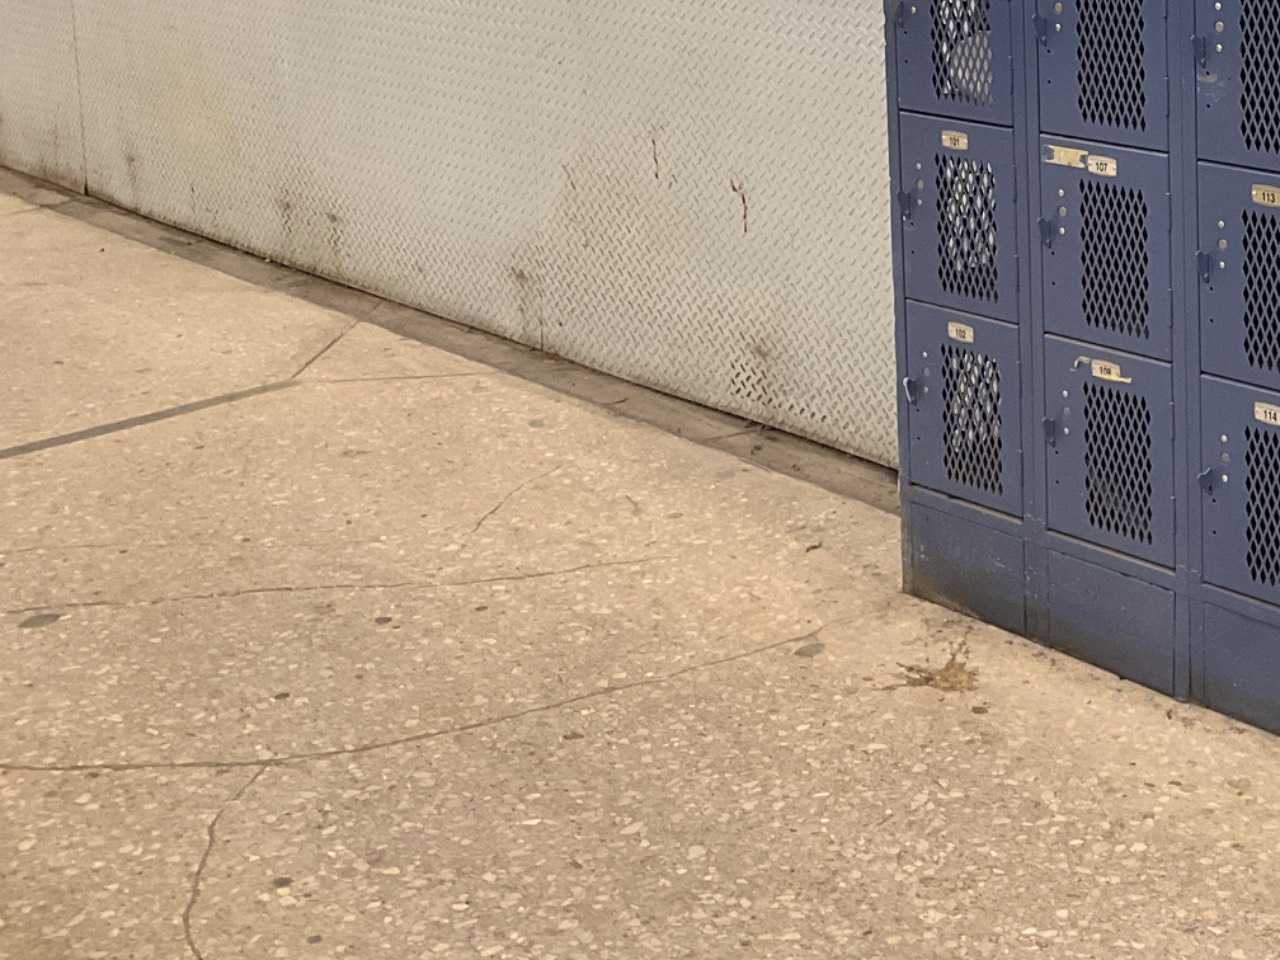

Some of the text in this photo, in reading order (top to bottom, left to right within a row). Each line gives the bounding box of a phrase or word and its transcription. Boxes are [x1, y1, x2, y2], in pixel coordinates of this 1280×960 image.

[1096, 162, 1107, 171] 107
[1262, 192, 1275, 202] 113
[1264, 410, 1277, 421] 114
